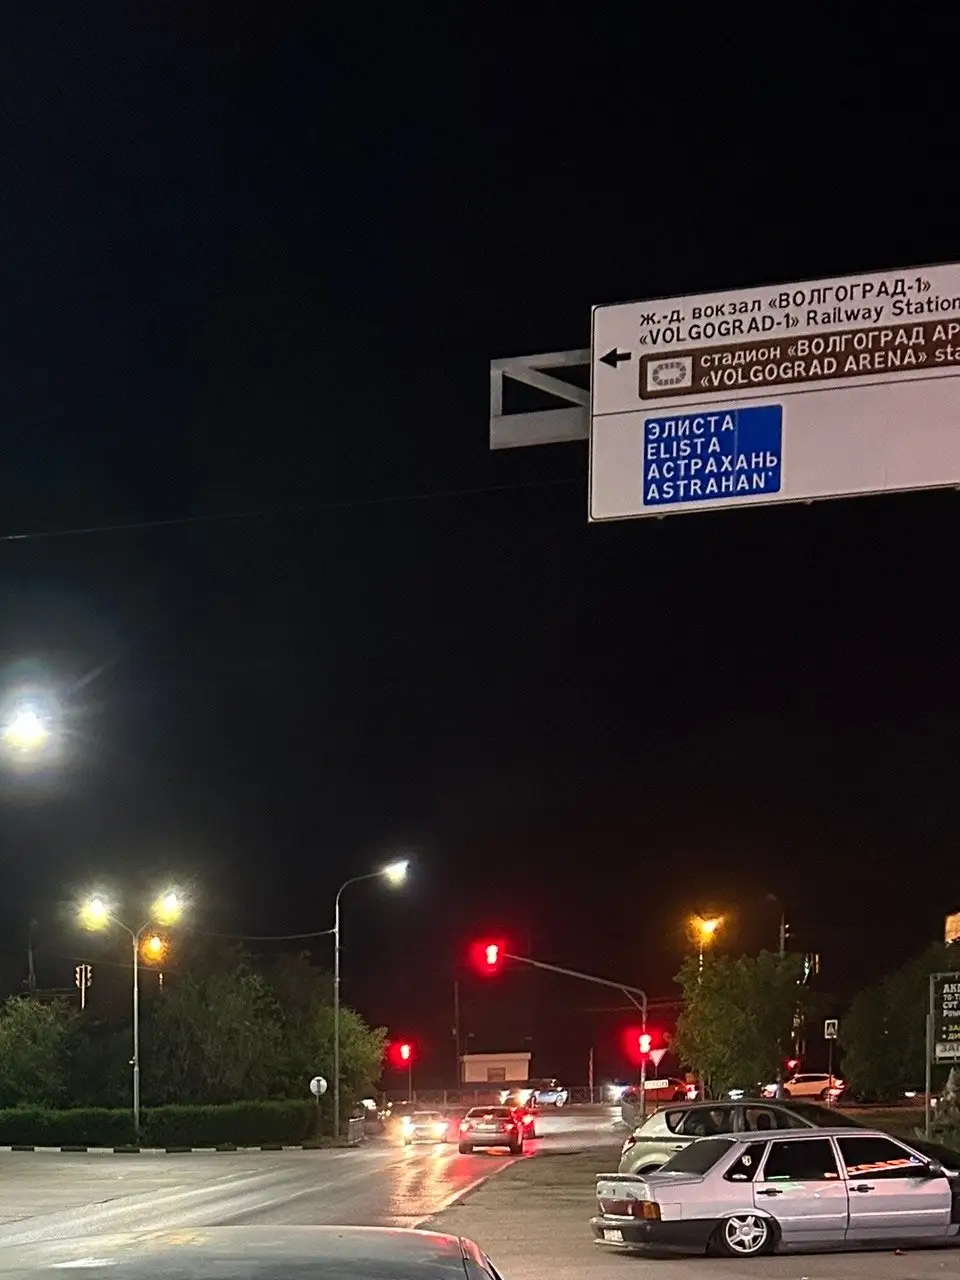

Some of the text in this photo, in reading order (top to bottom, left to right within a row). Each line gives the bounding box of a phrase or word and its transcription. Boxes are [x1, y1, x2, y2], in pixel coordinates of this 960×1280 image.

[692, 299, 761, 320] вокзал
[768, 277, 931, 309] «ВОЛГОГРАД-1»
[639, 296, 960, 345] «VOLGOGRAD-1» Railway Station
[700, 346, 781, 368] стадион
[787, 327, 925, 359] «ВОЛГОГРАД
[700, 357, 837, 388] «VOLGOGRAD
[844, 348, 927, 372] ARENA»
[648, 414, 734, 440] ЭЛИСТА
[647, 437, 720, 460] ELISTA
[647, 451, 778, 480] АСТРАХАНЬ
